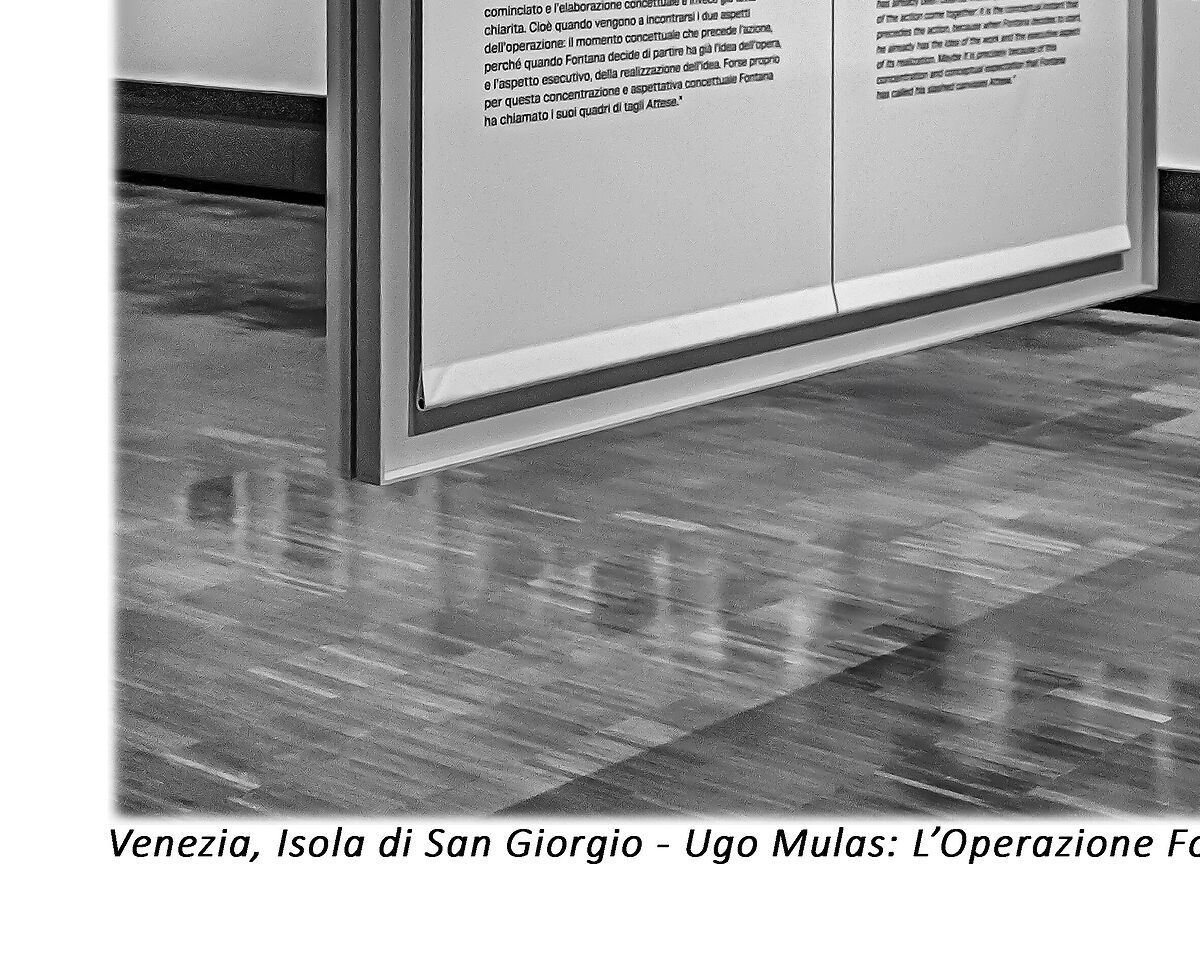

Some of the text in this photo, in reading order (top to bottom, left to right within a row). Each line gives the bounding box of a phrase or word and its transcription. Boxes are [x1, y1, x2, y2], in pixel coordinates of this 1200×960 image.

[483, 4, 543, 18] cominciato
[545, 4, 551, 14] e
[528, 20, 552, 33] Cioè
[554, 18, 592, 33] quando
[594, 16, 636, 30] vengono
[568, 36, 573, 48] il
[575, 34, 623, 47] momento
[484, 57, 521, 74] perché
[523, 55, 563, 71] quando
[565, 53, 605, 66] Fontana
[607, 49, 640, 62] decide
[483, 80, 491, 91] e
[594, 68, 618, 80] della
[484, 86, 620, 111] per questa concentrazione
[484, 115, 497, 127] ha
[499, 110, 548, 126] chiamato
[550, 108, 553, 120] i
[555, 106, 576, 120] suoi
[578, 103, 610, 119] quadri
[612, 101, 621, 113] di
